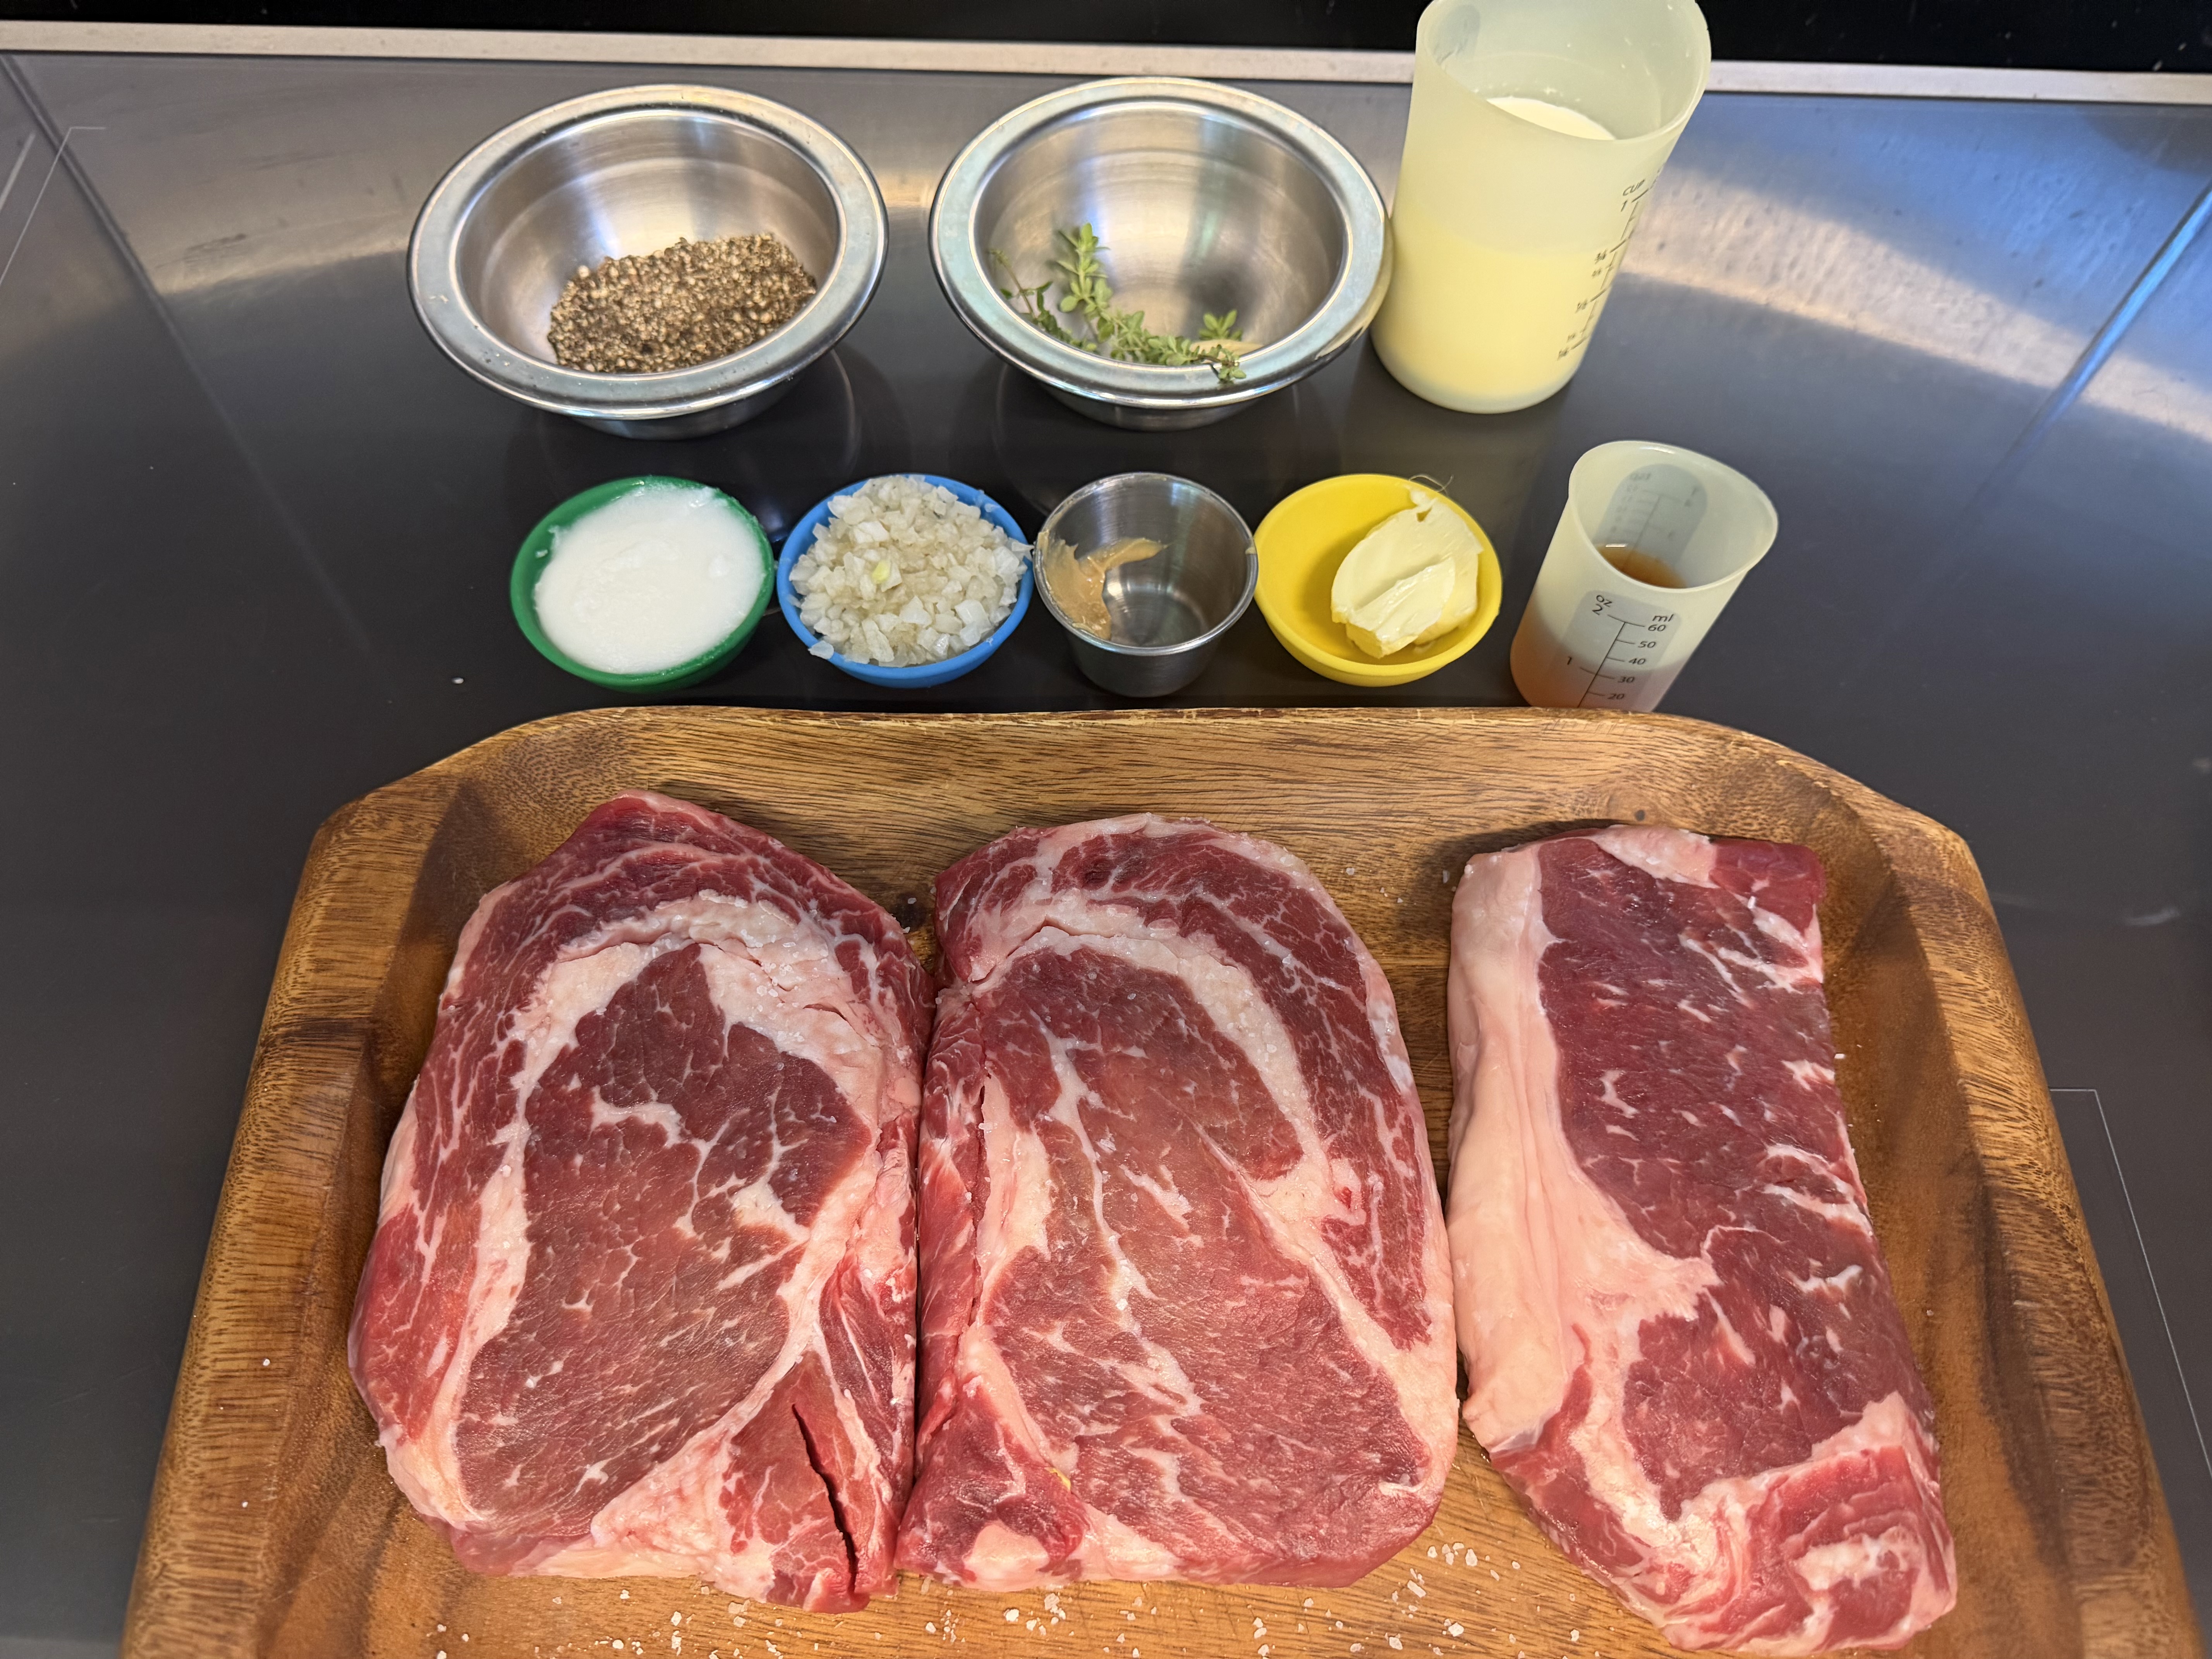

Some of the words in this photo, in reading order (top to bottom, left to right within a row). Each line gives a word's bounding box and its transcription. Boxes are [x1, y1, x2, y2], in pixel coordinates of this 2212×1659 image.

[1596, 594, 1613, 608] oz
[1592, 603, 1603, 615] 2
[1652, 613, 1674, 622] ml
